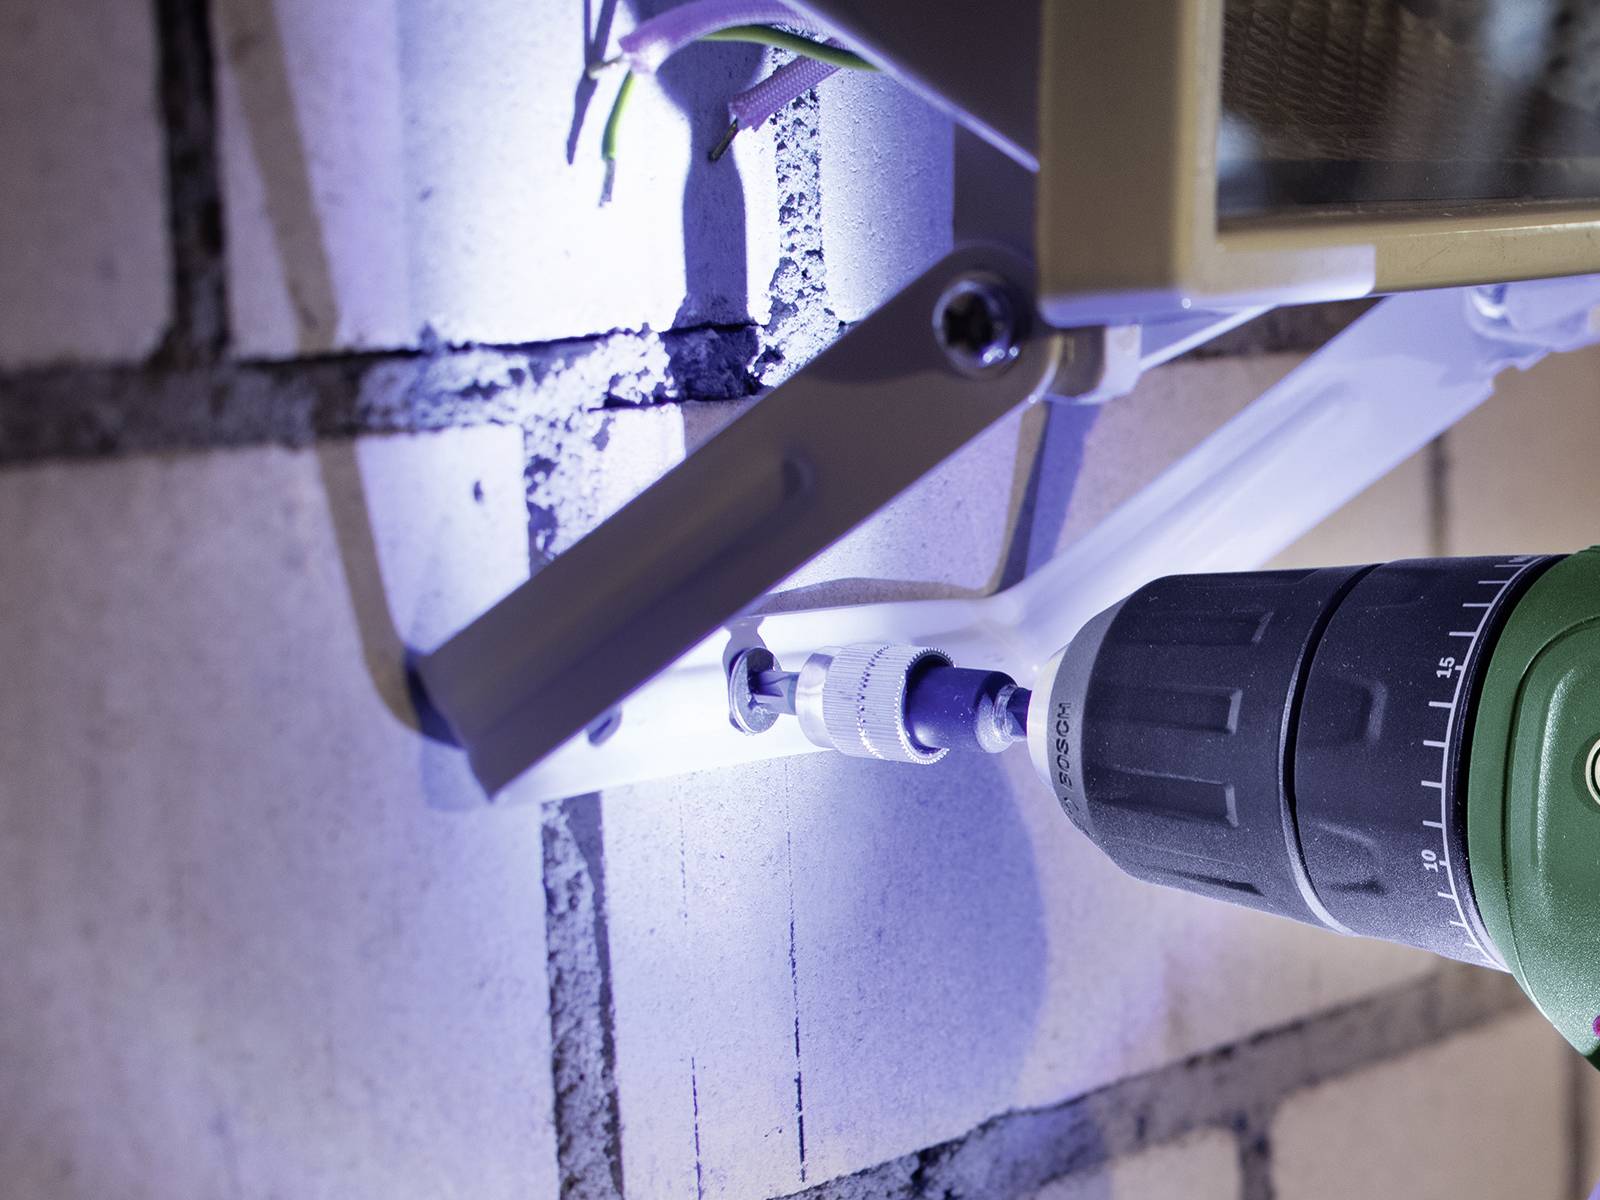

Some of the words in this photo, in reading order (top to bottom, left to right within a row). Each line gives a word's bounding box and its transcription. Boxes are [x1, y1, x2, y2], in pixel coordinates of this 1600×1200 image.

[1436, 656, 1455, 678] 15
[1056, 702, 1073, 790] BOSCH
[1421, 849, 1438, 872] 10
